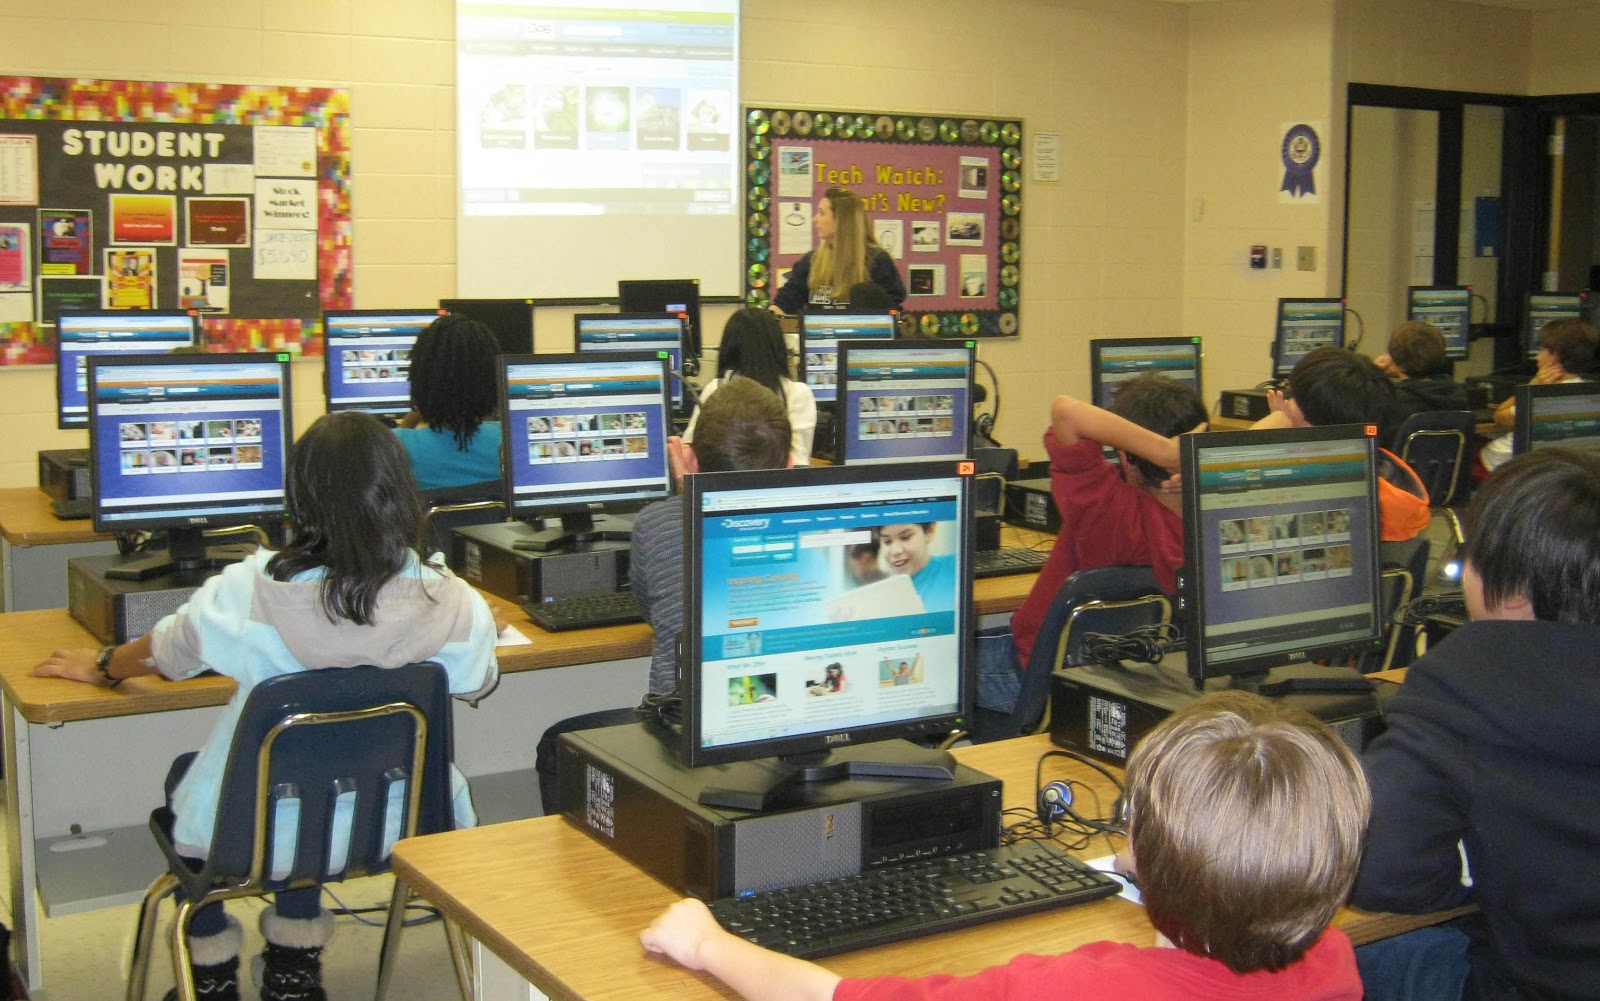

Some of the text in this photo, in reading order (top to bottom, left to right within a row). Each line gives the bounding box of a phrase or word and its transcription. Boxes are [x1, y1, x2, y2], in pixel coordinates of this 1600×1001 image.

[63, 129, 225, 157] STUDENT
[94, 163, 204, 191] WORK
[815, 163, 863, 184] Tech
[897, 192, 946, 214] New?
[962, 465, 971, 473] 24
[721, 518, 771, 529] Discovery
[825, 733, 849, 743] DELL
